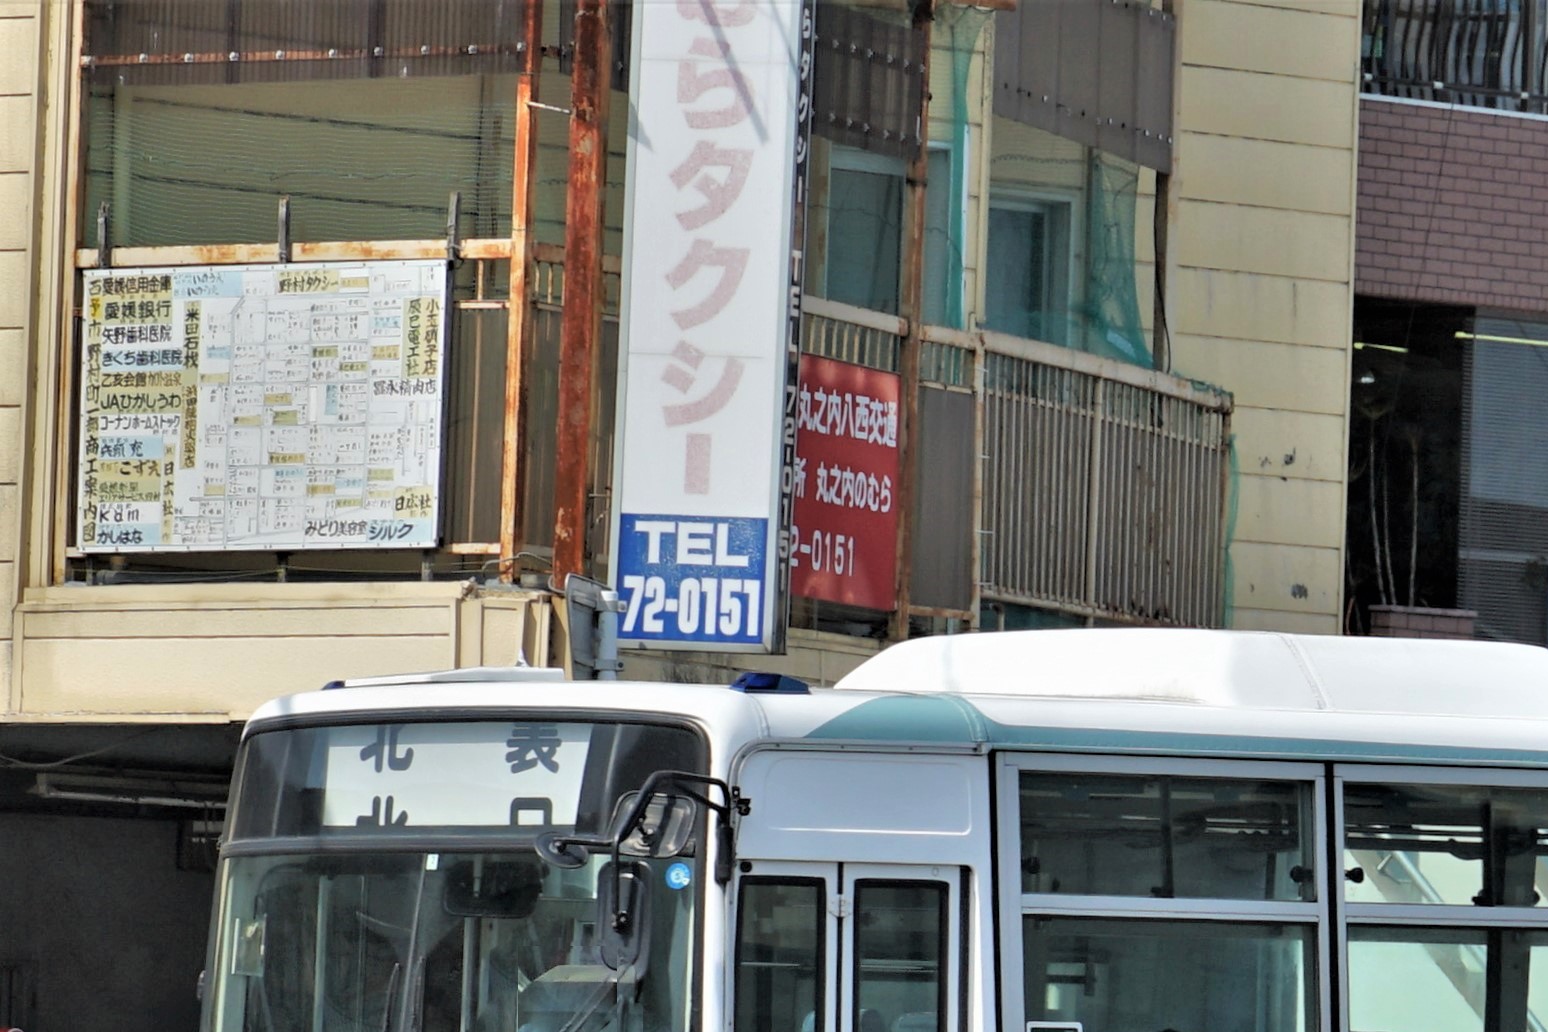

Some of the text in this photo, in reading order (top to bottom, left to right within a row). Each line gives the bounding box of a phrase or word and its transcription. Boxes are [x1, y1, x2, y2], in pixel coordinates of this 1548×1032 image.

[278, 273, 339, 293] 野村タクシー
[105, 300, 171, 320] 愛媛銀行
[788, 250, 802, 353] TEL
[102, 324, 173, 344] 矢野歯科医院
[102, 349, 183, 367] きくち歯科医院
[100, 392, 182, 410] JAひがしうわ
[798, 382, 897, 448] 丸之内八西交通
[778, 386, 797, 591] 72-0151
[815, 461, 892, 513] 丸之内のむら
[368, 523, 413, 541] シルク
[635, 520, 749, 567] TEL
[621, 575, 760, 637] 72-0151
